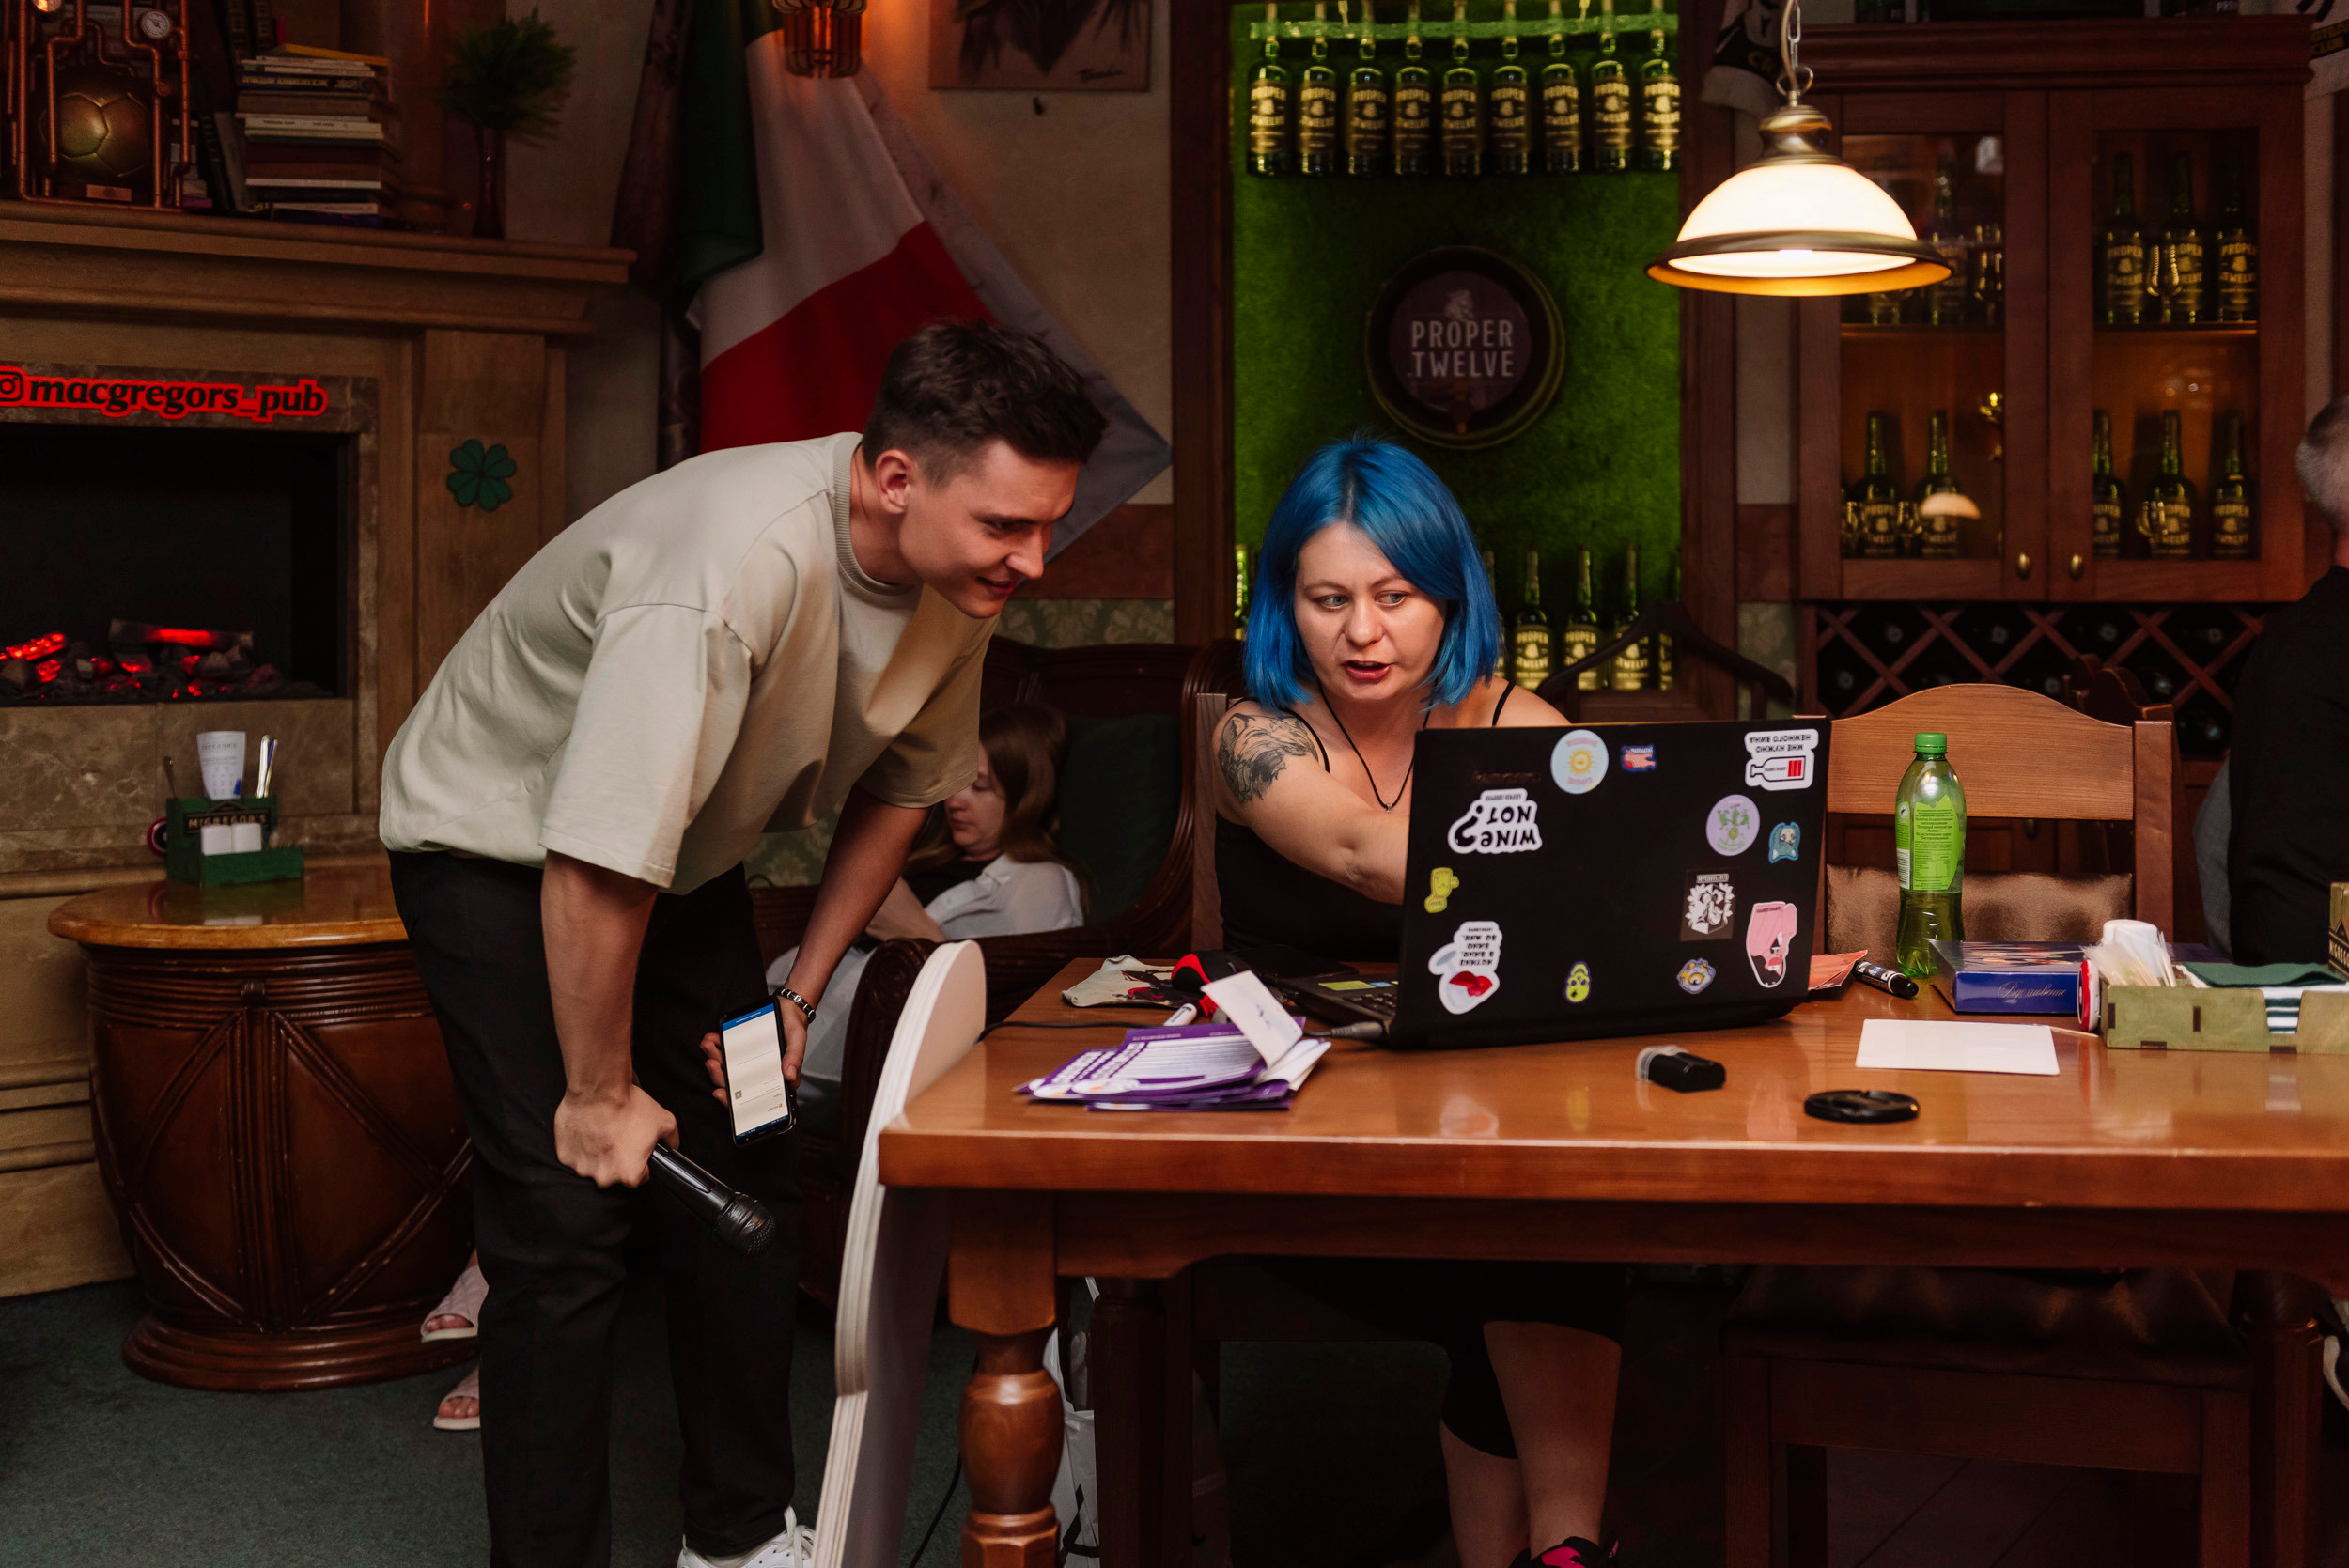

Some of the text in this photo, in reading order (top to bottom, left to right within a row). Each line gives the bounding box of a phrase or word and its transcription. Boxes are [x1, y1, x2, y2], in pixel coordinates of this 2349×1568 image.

[1411, 319, 1514, 348] PROPER
[1411, 350, 1514, 378] TWELVE
[29, 380, 324, 418] macgregors_pub
